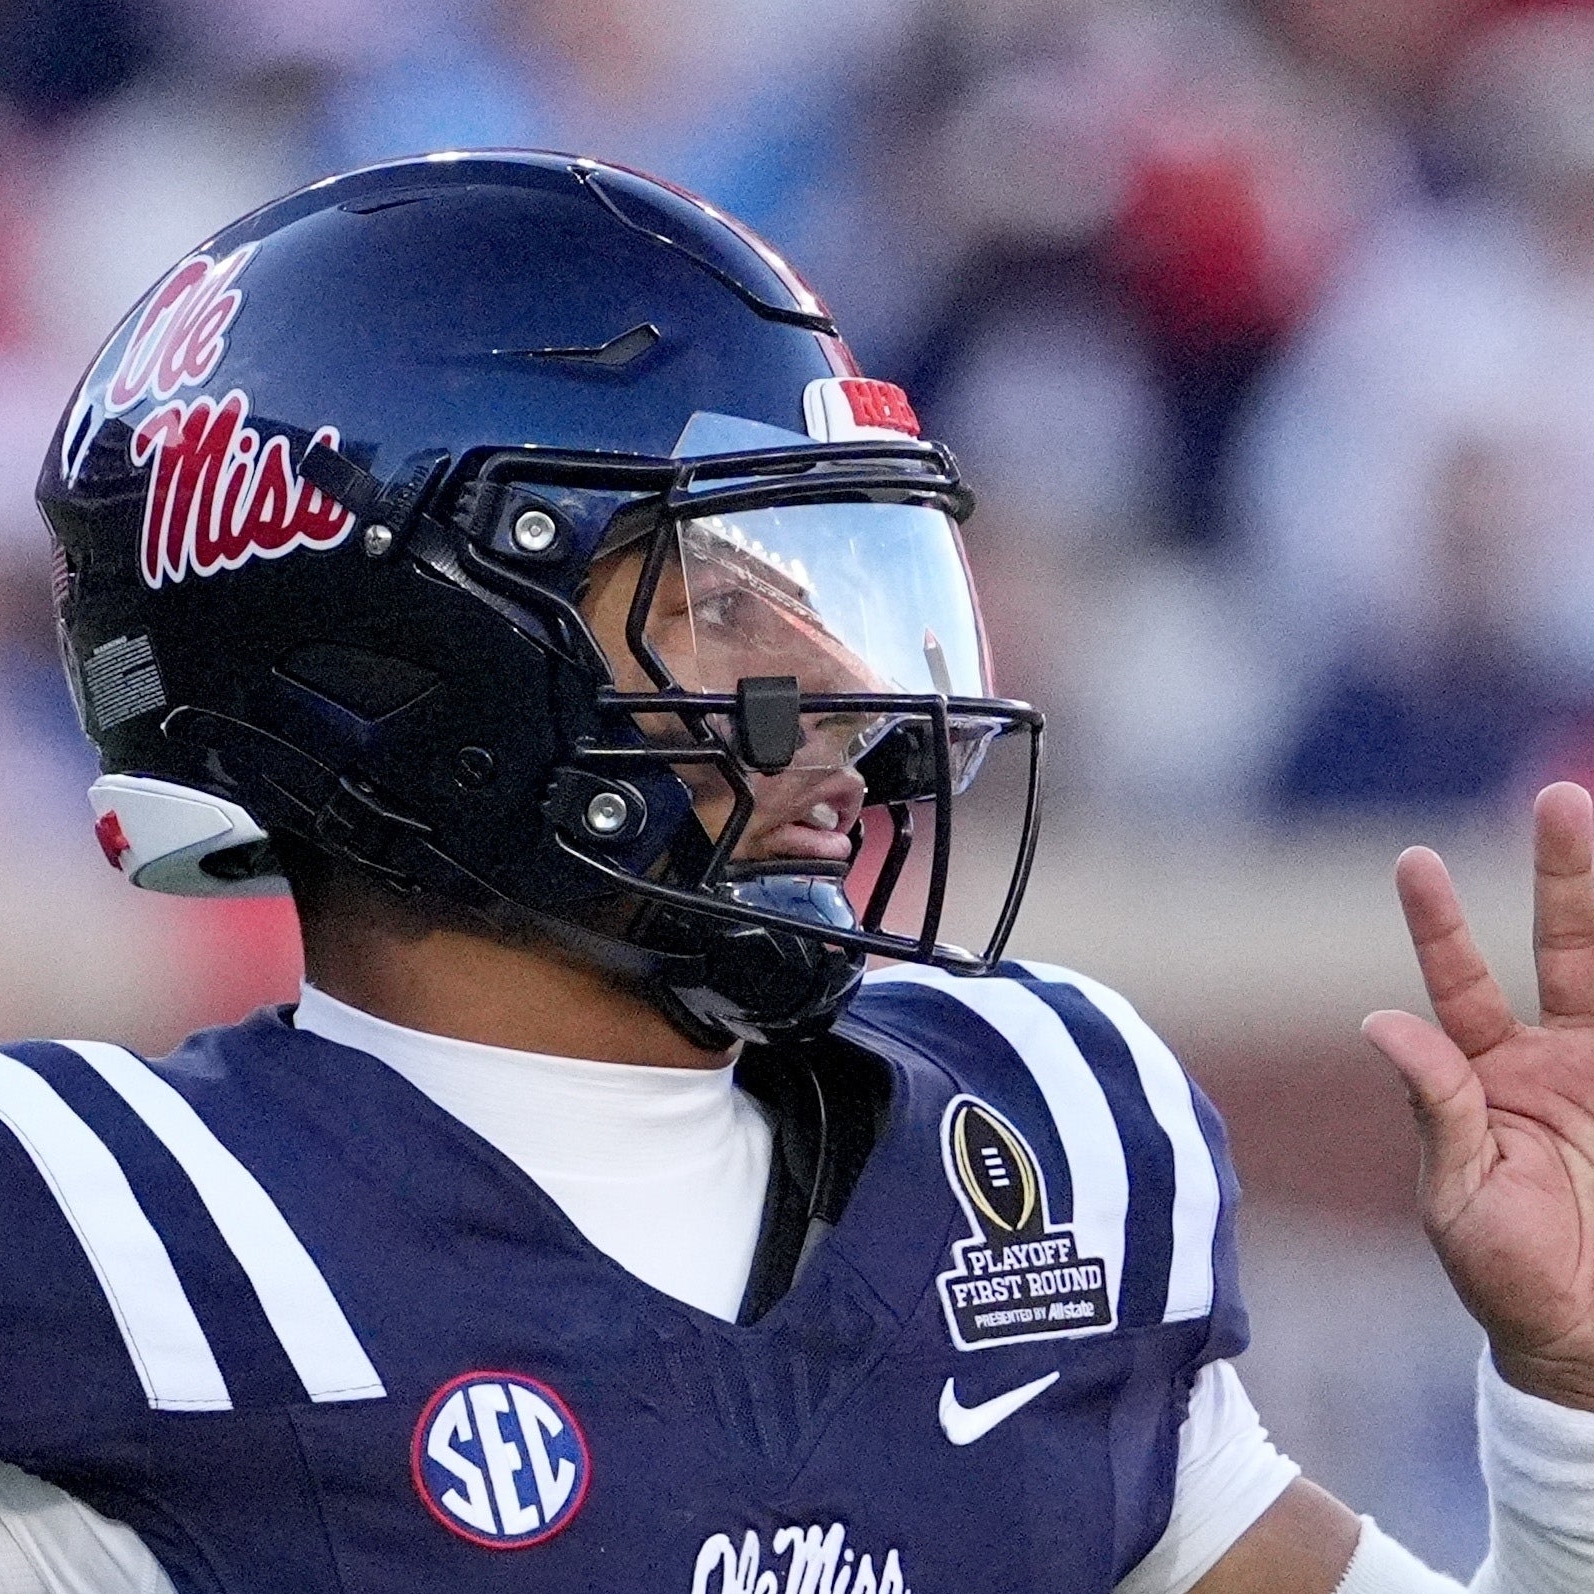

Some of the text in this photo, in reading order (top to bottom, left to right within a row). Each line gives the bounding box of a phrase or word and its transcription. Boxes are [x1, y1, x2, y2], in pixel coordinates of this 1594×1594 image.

[105, 242, 261, 413] Ole
[131, 388, 356, 589] Miss
[952, 1265, 1102, 1308] FIRST ROUND
[967, 1238, 1072, 1276] PLAYOFF
[974, 1300, 1095, 1329] PRESENTED BY Allstate
[427, 1383, 576, 1535] SEC
